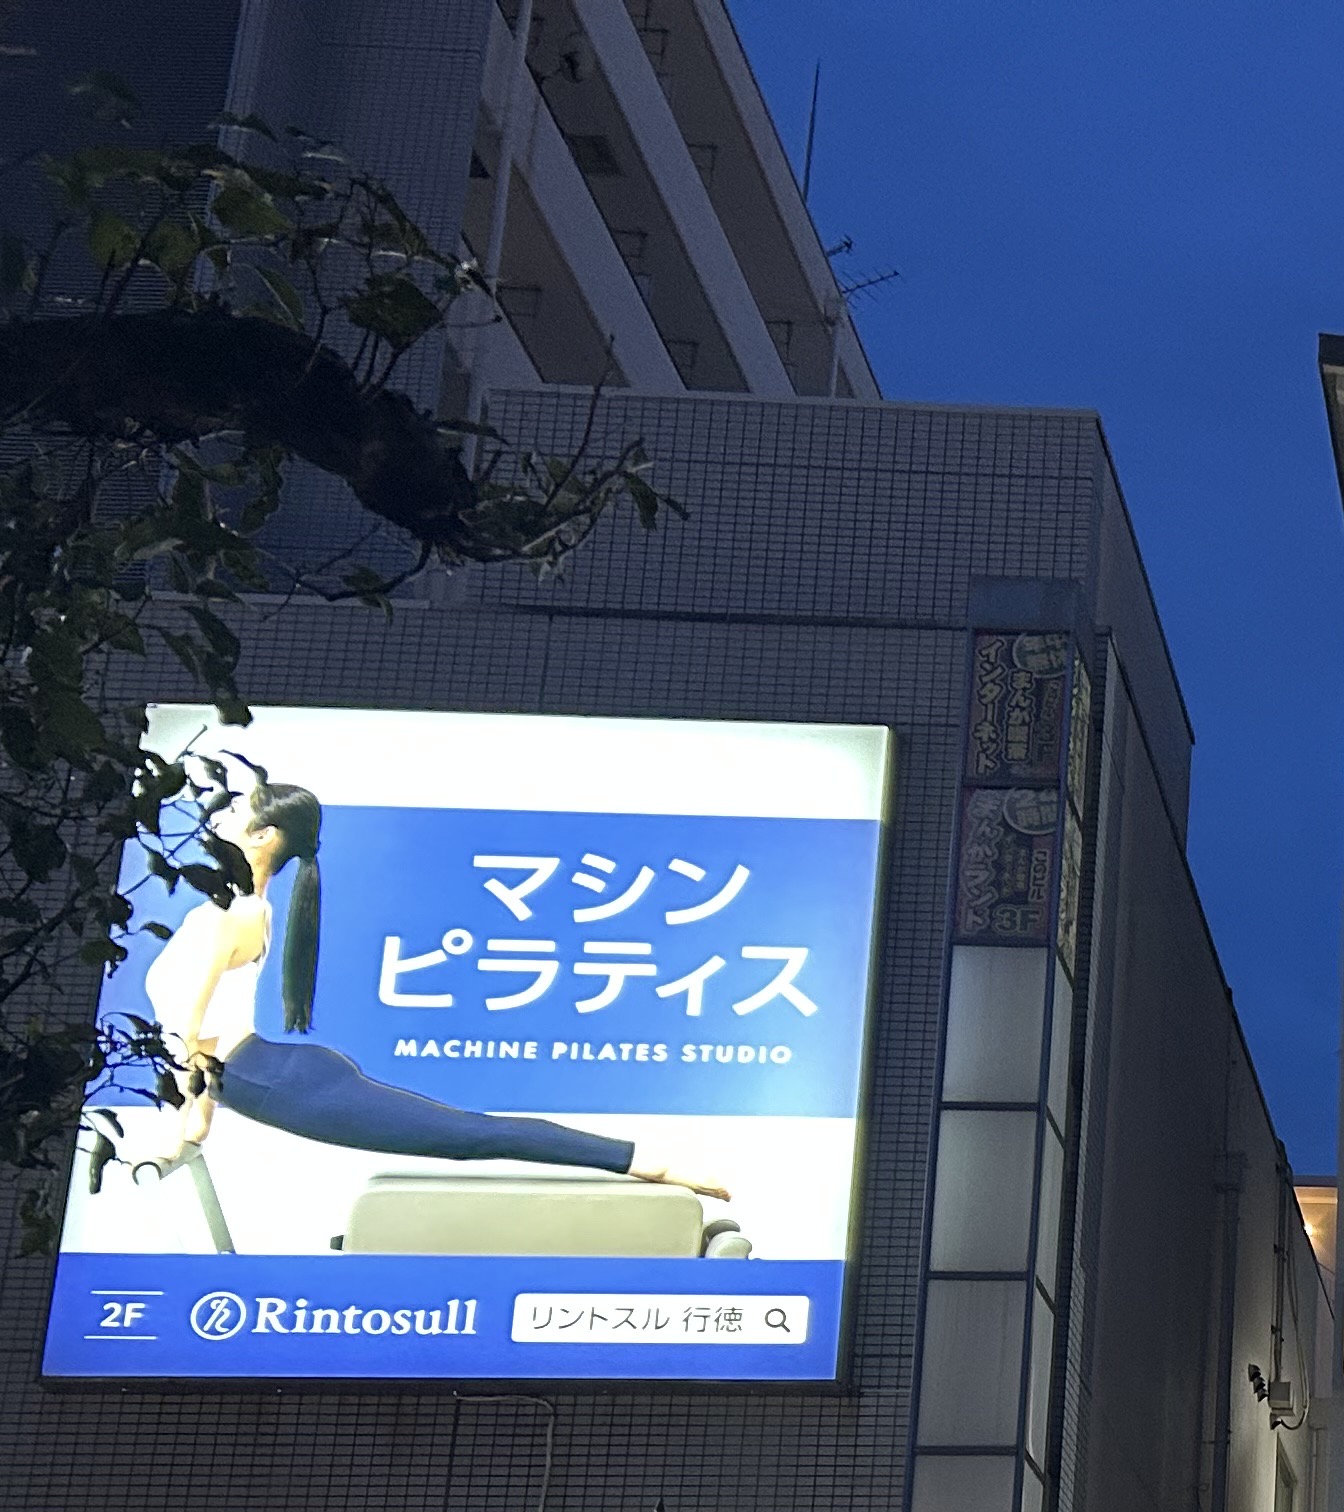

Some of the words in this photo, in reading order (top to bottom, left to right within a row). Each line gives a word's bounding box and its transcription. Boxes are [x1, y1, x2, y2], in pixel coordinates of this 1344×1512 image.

[472, 852, 751, 925] マシン
[377, 928, 820, 1018] ピラティス
[394, 1039, 538, 1061] MACHINE
[552, 1041, 669, 1063] PILATES
[681, 1043, 793, 1066] STUDIO
[100, 1302, 146, 1330] 2F
[255, 1297, 479, 1337] Rintosull
[530, 1305, 670, 1335] リントスル
[681, 1305, 744, 1336] 行徳
